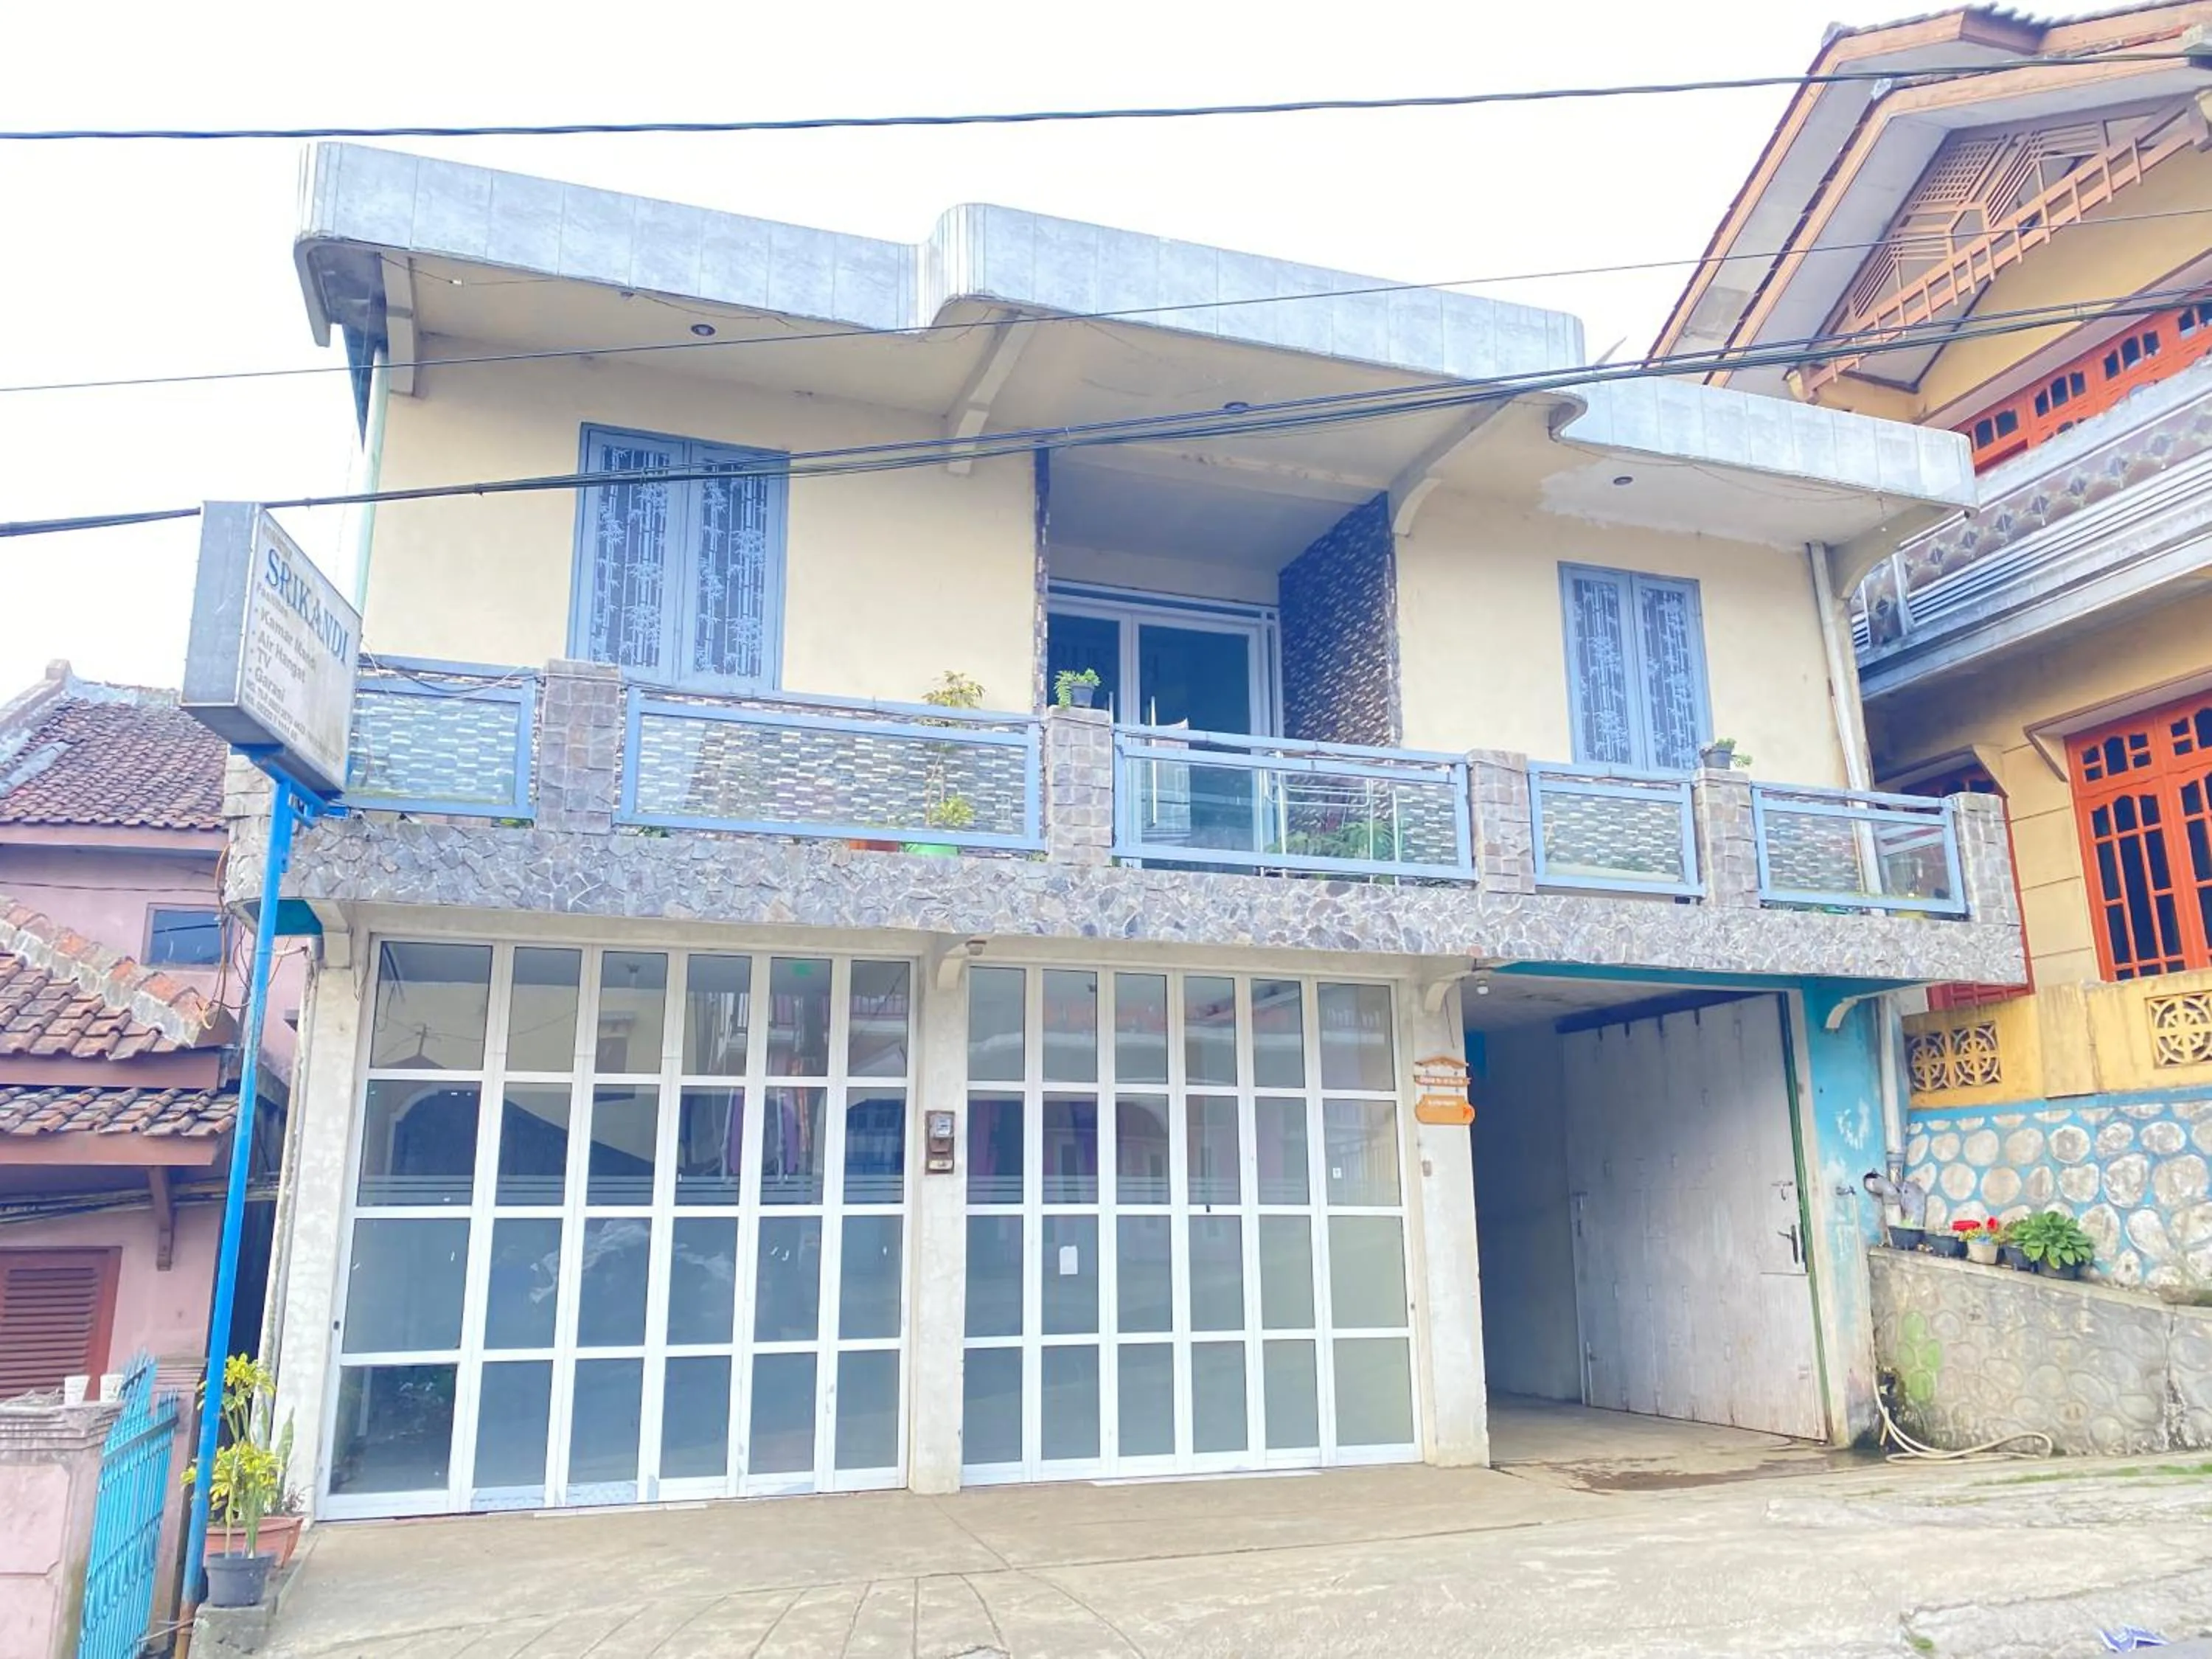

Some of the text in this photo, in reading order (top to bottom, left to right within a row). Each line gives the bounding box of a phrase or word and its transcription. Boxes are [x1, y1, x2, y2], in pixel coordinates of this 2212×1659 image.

[265, 548, 349, 662] SRIKANDI
[260, 607, 293, 646] Kamar
[257, 629, 306, 684] Air Hangat
[257, 646, 271, 669] TV
[254, 666, 285, 703] Garasi
